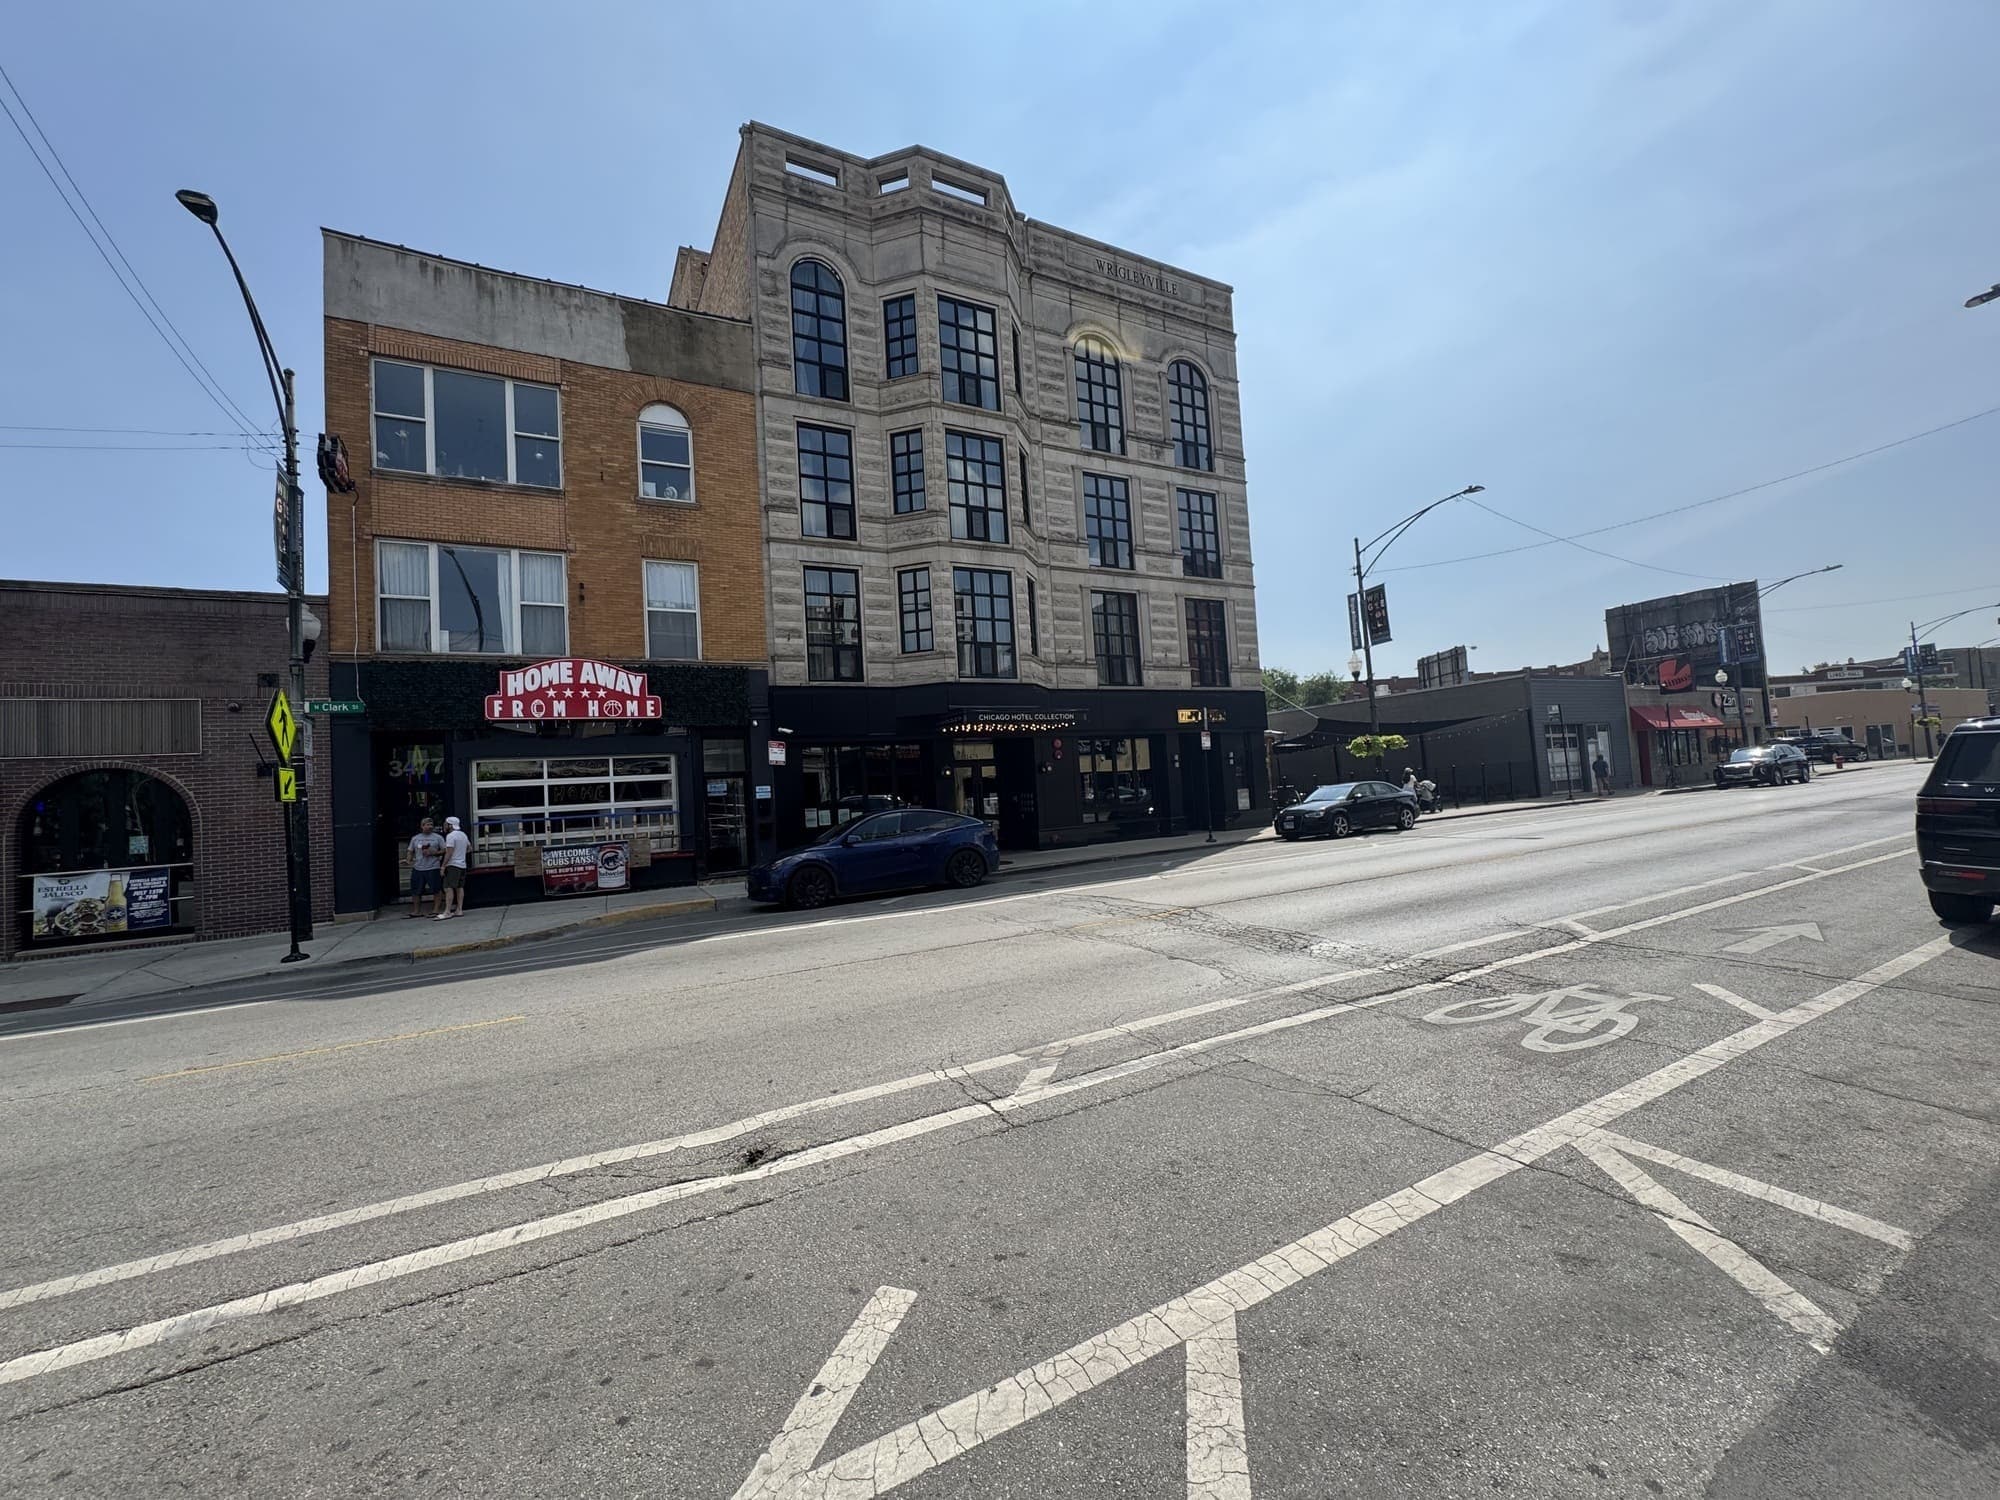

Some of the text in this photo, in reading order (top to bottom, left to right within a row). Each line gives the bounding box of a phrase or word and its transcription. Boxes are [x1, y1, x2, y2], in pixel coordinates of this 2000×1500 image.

[1096, 259, 1178, 295] WRIGLEYVILLE
[507, 662, 643, 697] HOME AWAY
[322, 703, 349, 711] Clark
[979, 713, 1010, 721] CHICAGO
[1034, 712, 1074, 720] COLLECTION
[551, 848, 590, 858] WELCOME
[547, 855, 594, 867] CUBS FANS!
[38, 884, 88, 893] ESTRELLA
[42, 890, 84, 898] JALISCO
